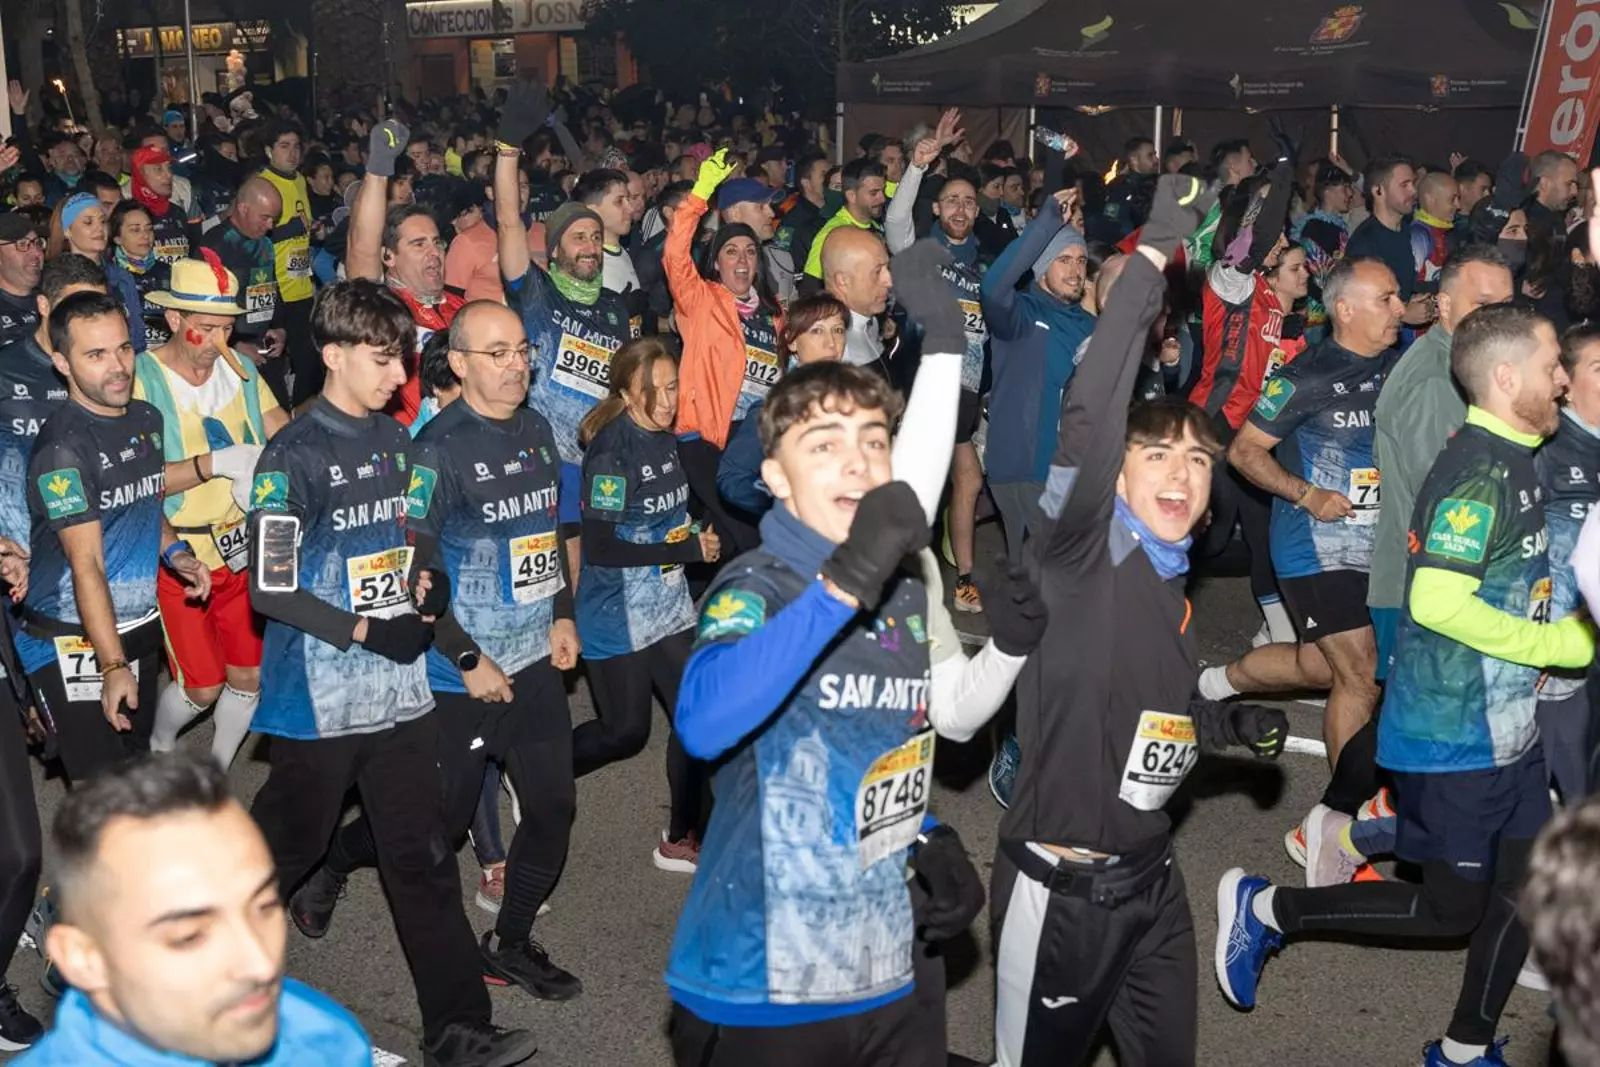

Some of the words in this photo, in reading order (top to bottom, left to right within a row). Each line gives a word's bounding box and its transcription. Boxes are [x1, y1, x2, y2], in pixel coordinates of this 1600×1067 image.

[410, 7, 513, 34] CONFECCIONS
[562, 350, 610, 381] 9965
[12, 418, 47, 437] SA
[1333, 410, 1370, 429] SAN
[99, 483, 134, 510] SAN
[482, 496, 521, 524] SAN
[643, 491, 675, 515] SAN
[332, 502, 370, 532] SAN
[219, 526, 249, 553] 94
[818, 673, 876, 710] SAN
[863, 767, 926, 823] 8748
